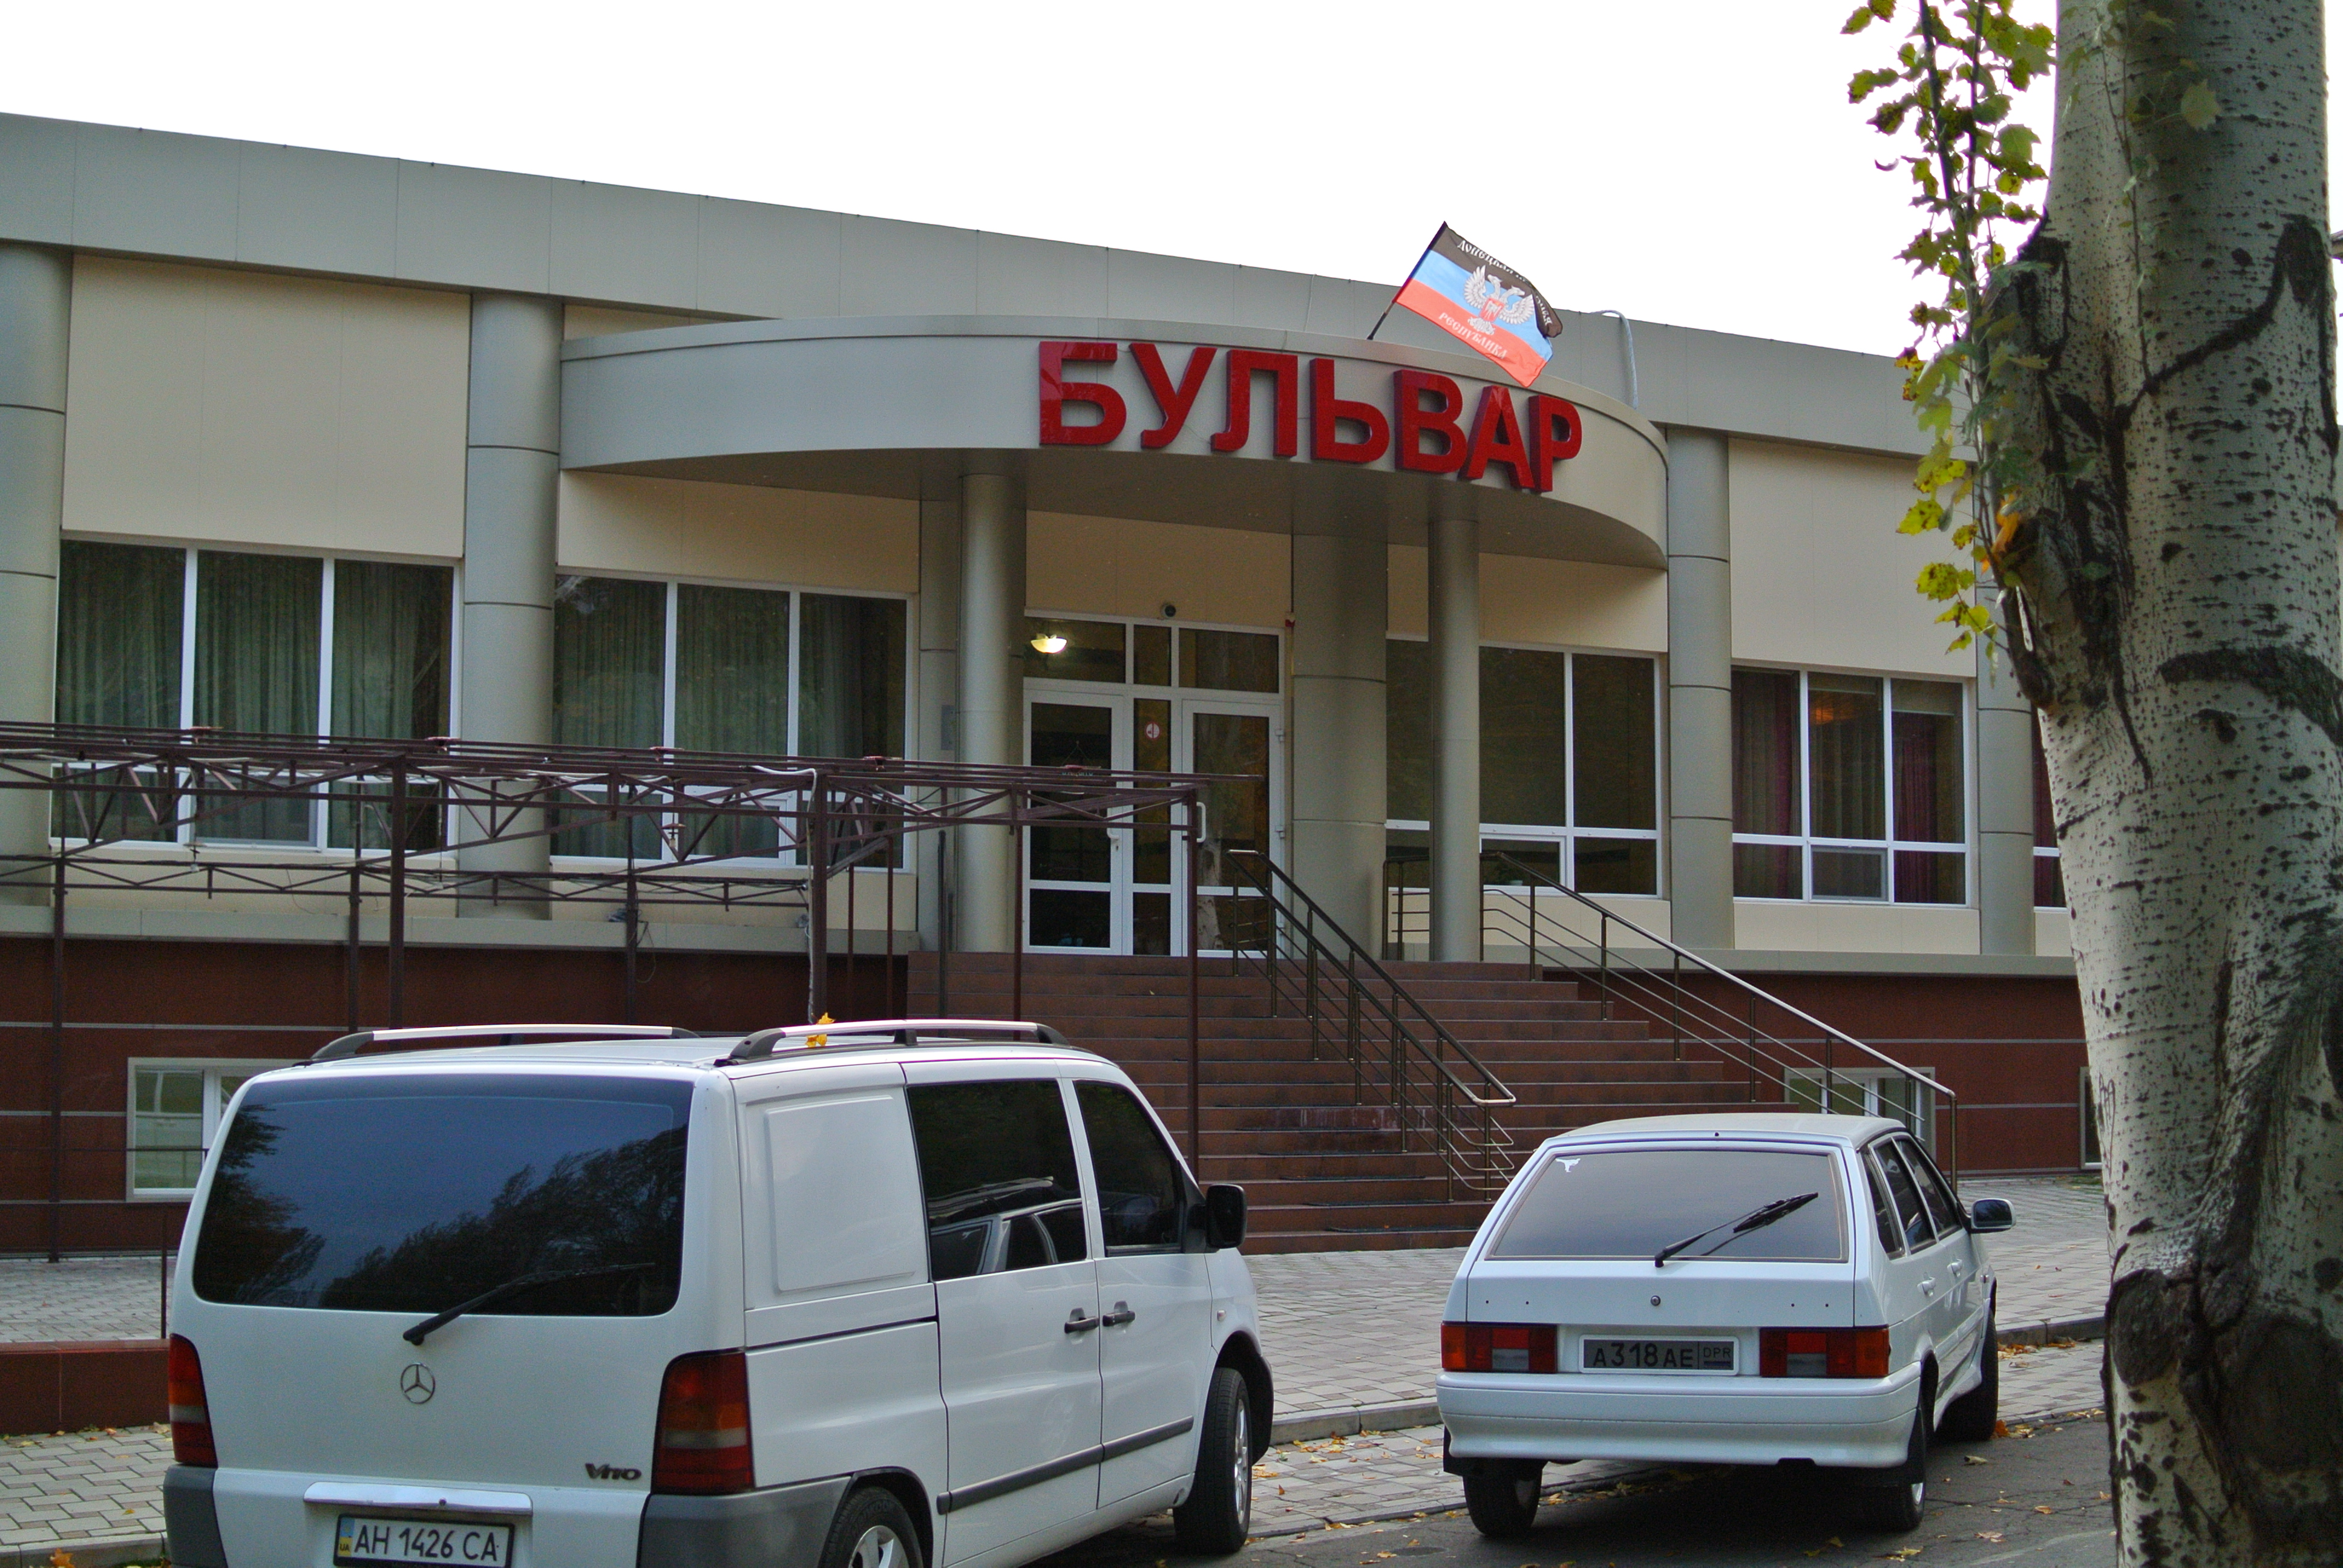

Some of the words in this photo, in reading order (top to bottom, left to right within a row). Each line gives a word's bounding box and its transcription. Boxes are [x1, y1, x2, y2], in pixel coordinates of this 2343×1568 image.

[1438, 312, 1508, 359] РЕСПУБЛИКА
[1038, 341, 1583, 492] БУЛЬВАР
[1703, 1347, 1731, 1358] DPR
[339, 1543, 350, 1552] UA
[354, 1524, 390, 1555] AH
[398, 1527, 455, 1559] 1426
[462, 1531, 497, 1561] CA
